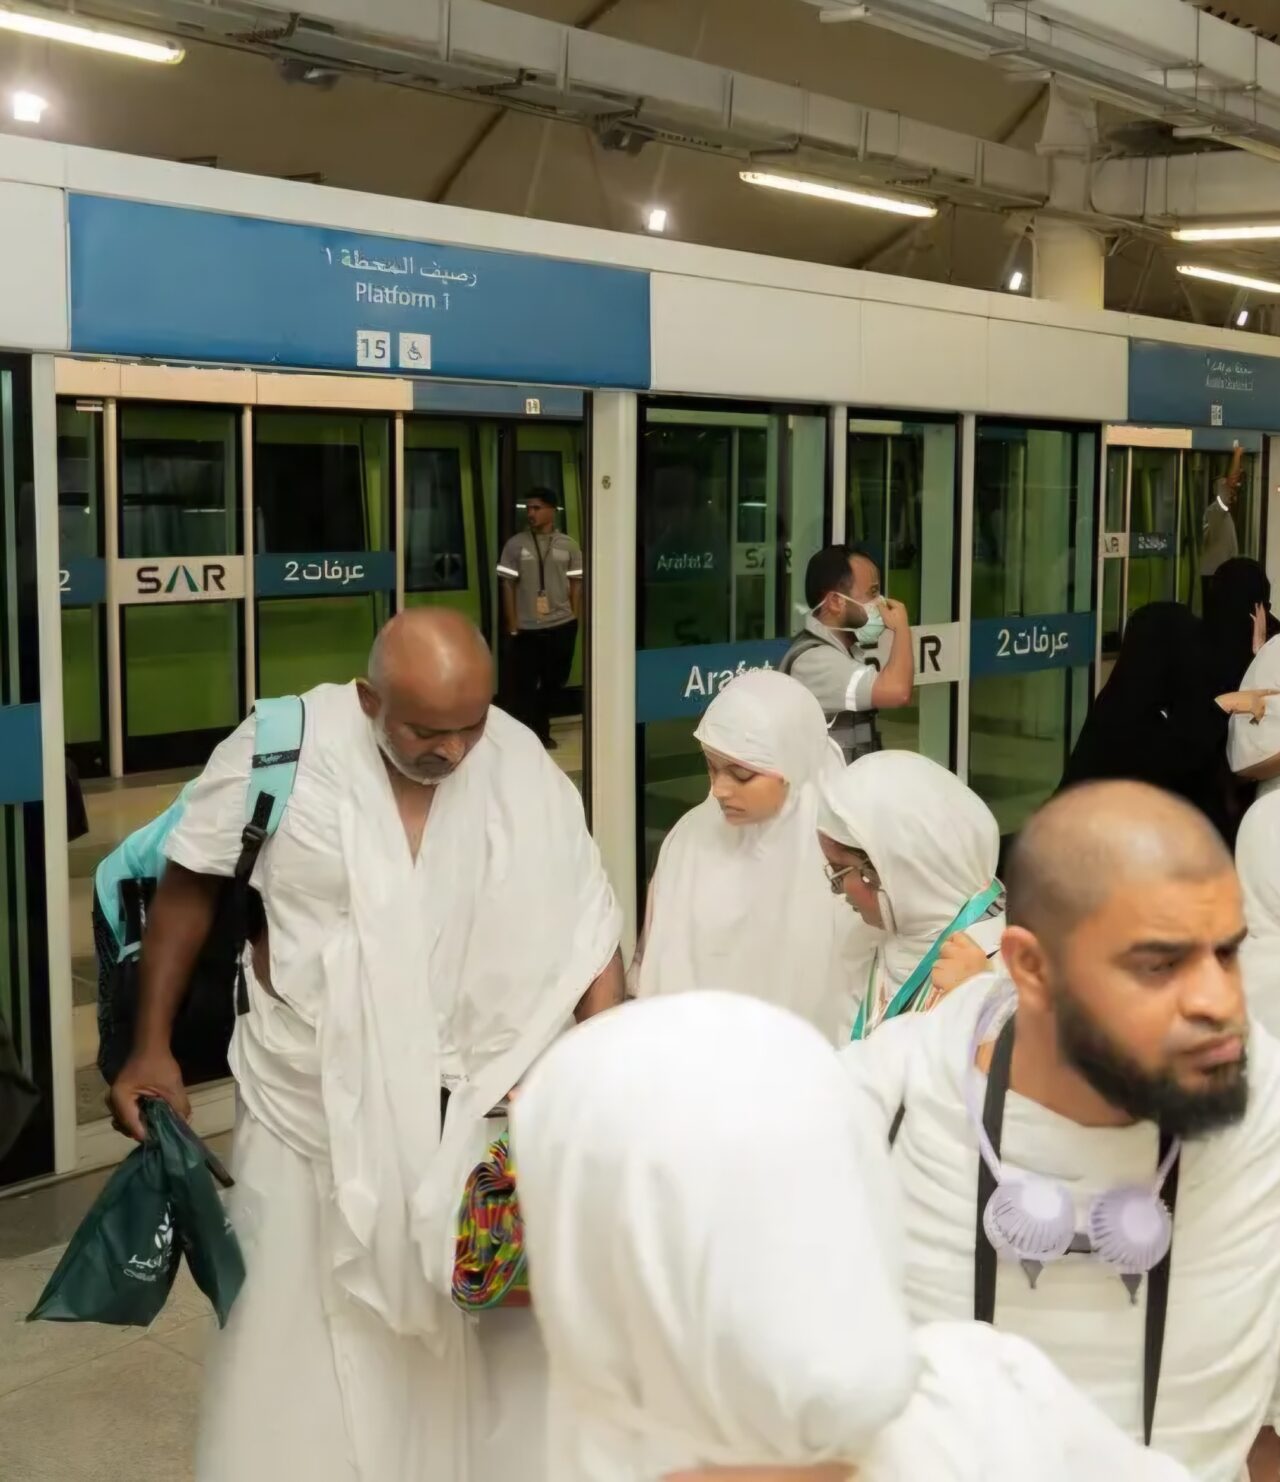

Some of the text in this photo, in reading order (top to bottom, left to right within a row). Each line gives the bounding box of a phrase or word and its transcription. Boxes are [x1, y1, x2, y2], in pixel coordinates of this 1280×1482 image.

[341, 249, 414, 275] المحطة
[419, 261, 477, 287] رصيف
[356, 282, 450, 310] Platform 1
[359, 338, 387, 360] 15
[136, 563, 226, 594] SAR
